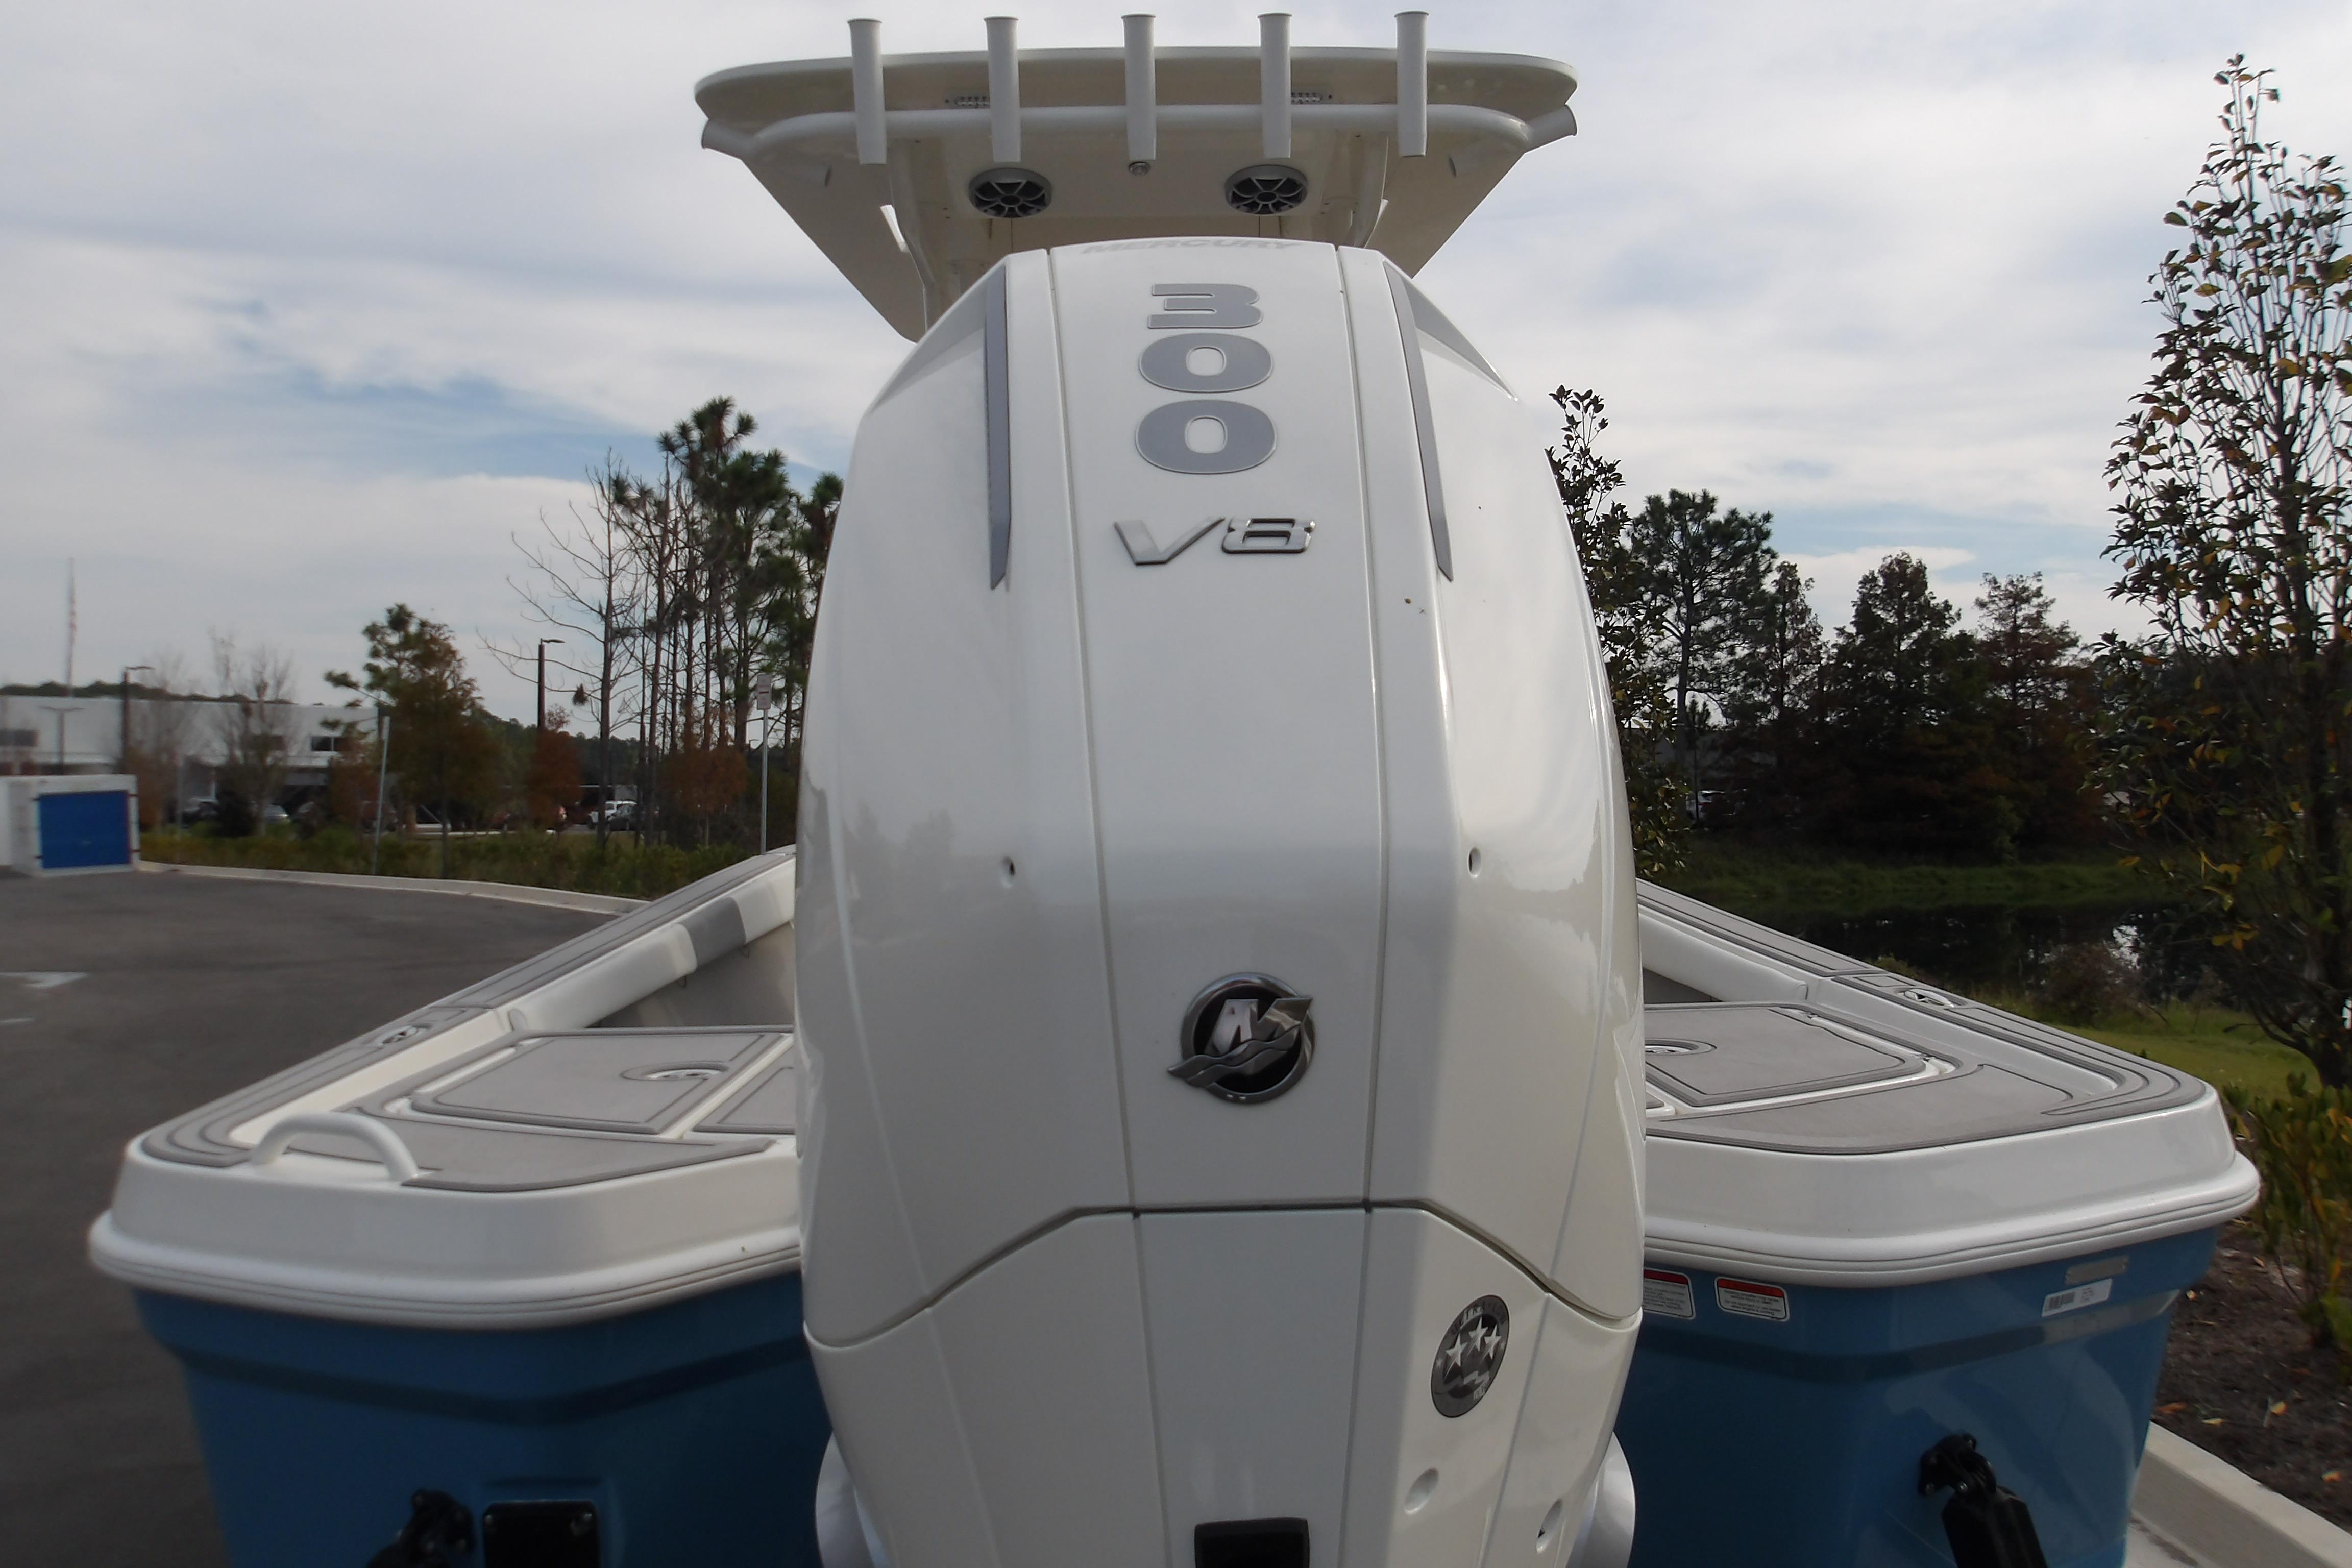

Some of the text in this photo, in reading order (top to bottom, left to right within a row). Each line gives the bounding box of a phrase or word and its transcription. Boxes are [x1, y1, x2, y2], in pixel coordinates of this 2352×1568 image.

[1080, 239, 1303, 255] MERCURY
[1135, 283, 1277, 474] 300
[1113, 516, 1316, 566] V8
